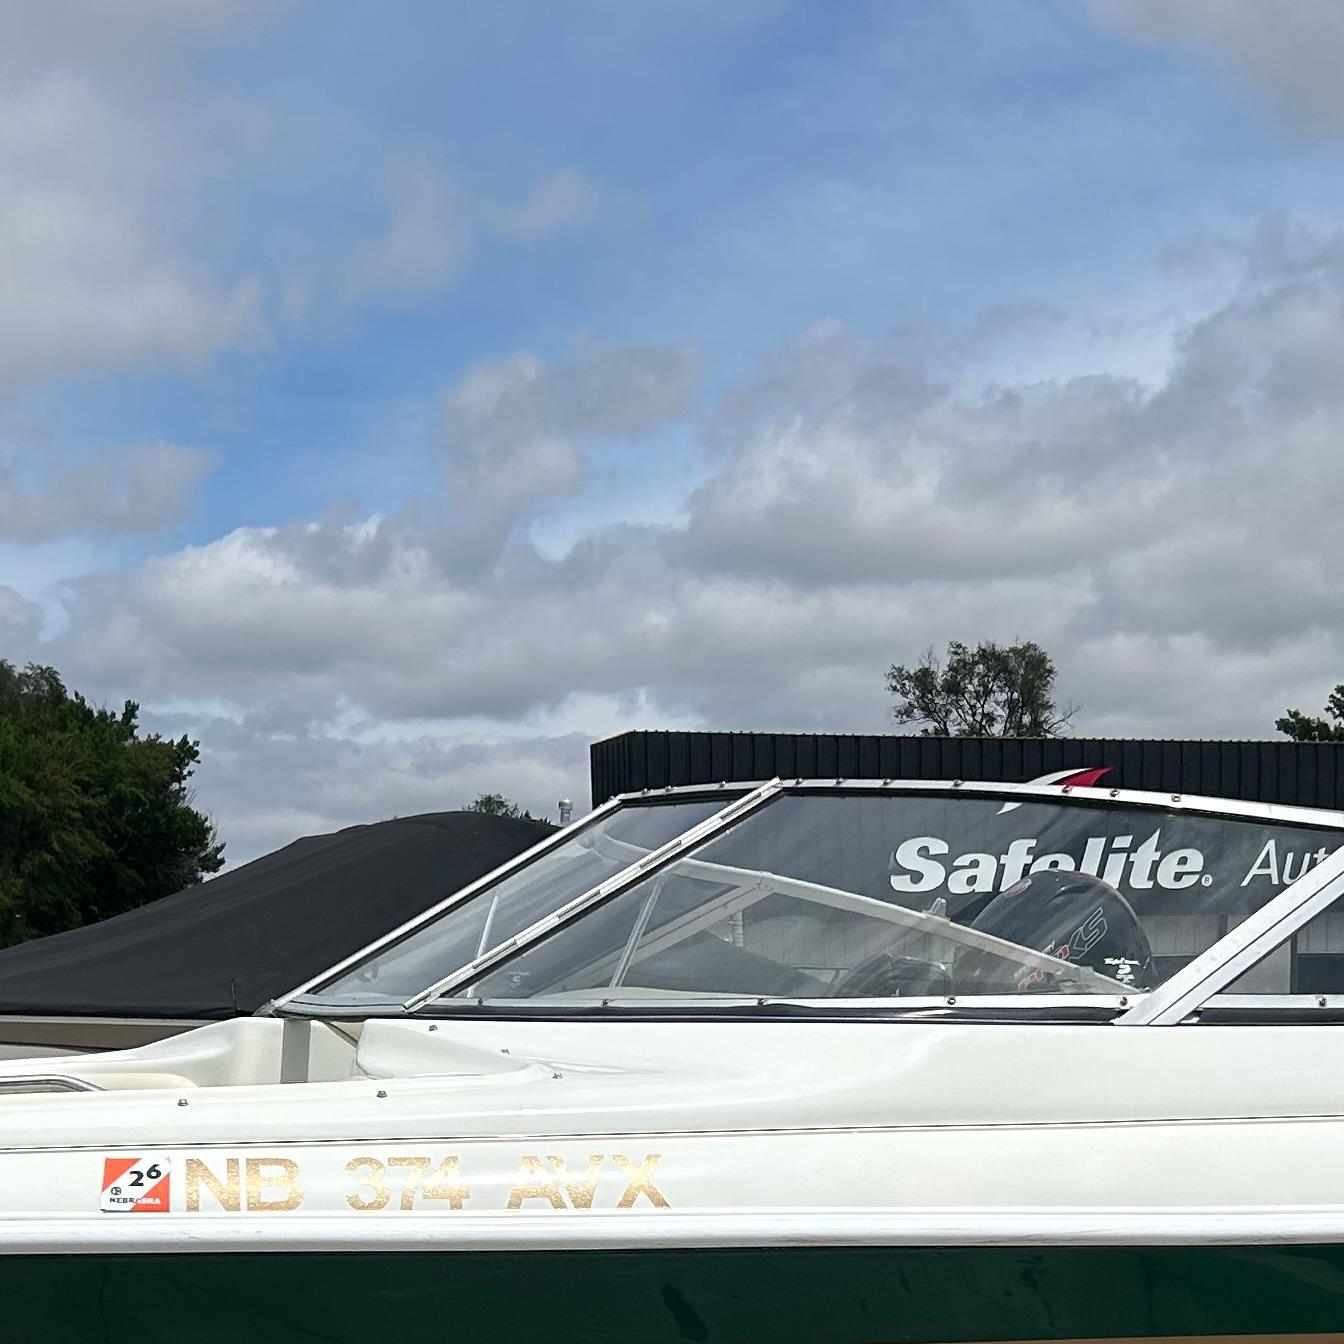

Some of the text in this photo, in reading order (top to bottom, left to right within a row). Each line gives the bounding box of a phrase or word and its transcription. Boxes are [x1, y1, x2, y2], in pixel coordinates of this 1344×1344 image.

[128, 1163, 162, 1187] 26
[185, 1153, 672, 1212] NB 374 AVX
